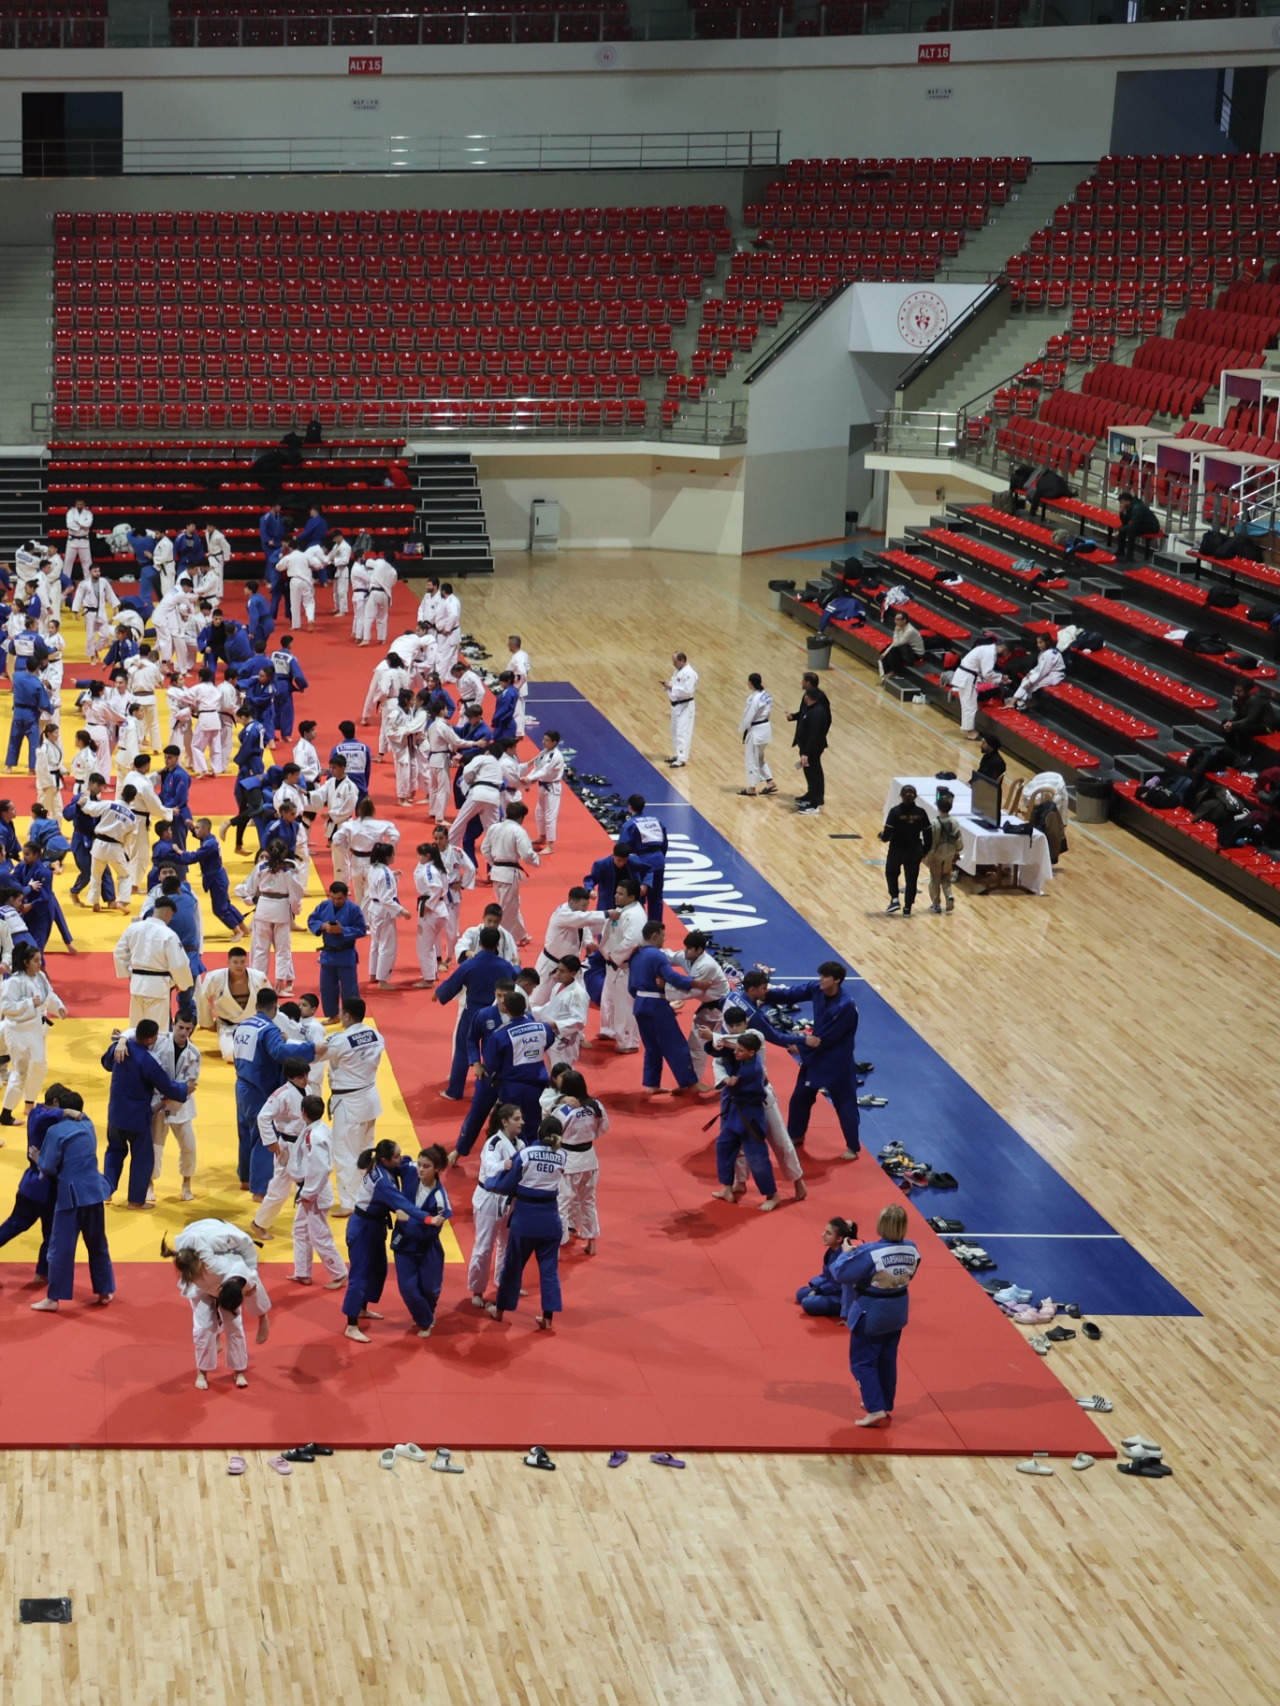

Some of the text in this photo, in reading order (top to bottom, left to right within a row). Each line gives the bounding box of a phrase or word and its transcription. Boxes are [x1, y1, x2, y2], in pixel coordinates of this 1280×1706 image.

[919, 47, 949, 59] ALT 16
[350, 60, 381, 70] ALT 15
[114, 813, 127, 823] TUR
[234, 1034, 251, 1045] KAZ
[522, 1036, 539, 1045] KAZ
[575, 1108, 593, 1119] GEO
[529, 1151, 562, 1164] VELIADZE
[536, 1162, 554, 1174] GEO
